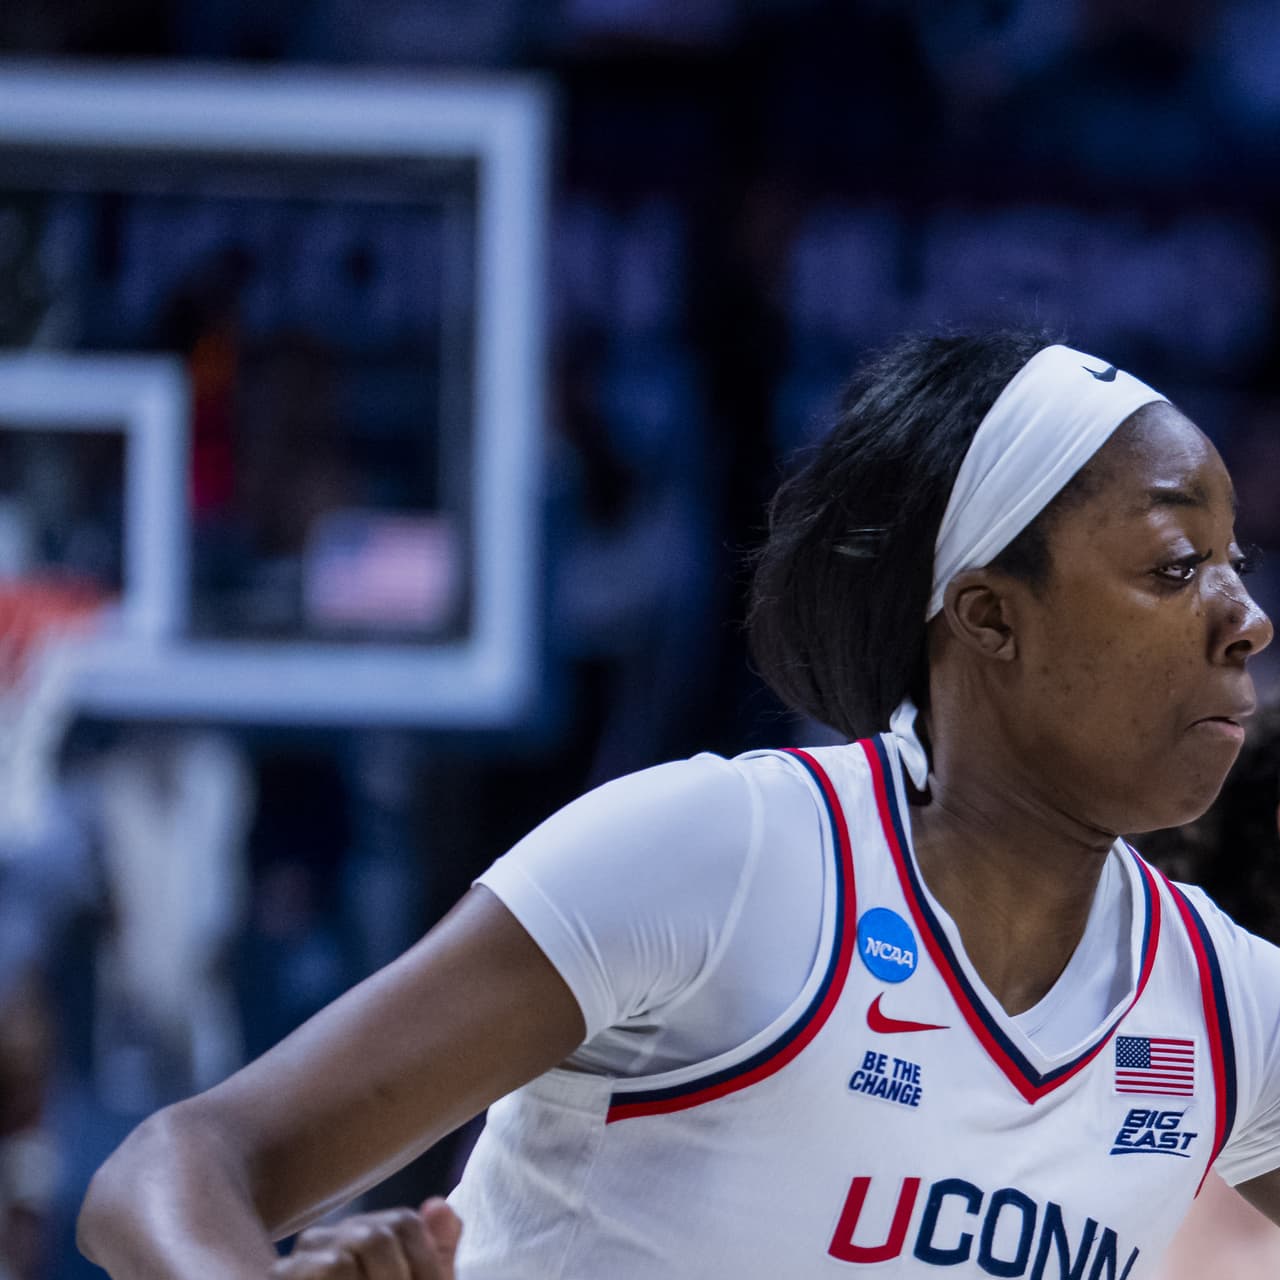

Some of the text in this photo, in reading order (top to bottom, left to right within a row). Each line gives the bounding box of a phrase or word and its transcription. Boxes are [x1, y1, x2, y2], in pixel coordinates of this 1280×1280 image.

[865, 938, 914, 969] NCAA
[862, 1050, 921, 1086] BE THE
[848, 1070, 923, 1107] CHANGE
[1123, 1109, 1184, 1129] BIG
[1114, 1128, 1198, 1150] EAST
